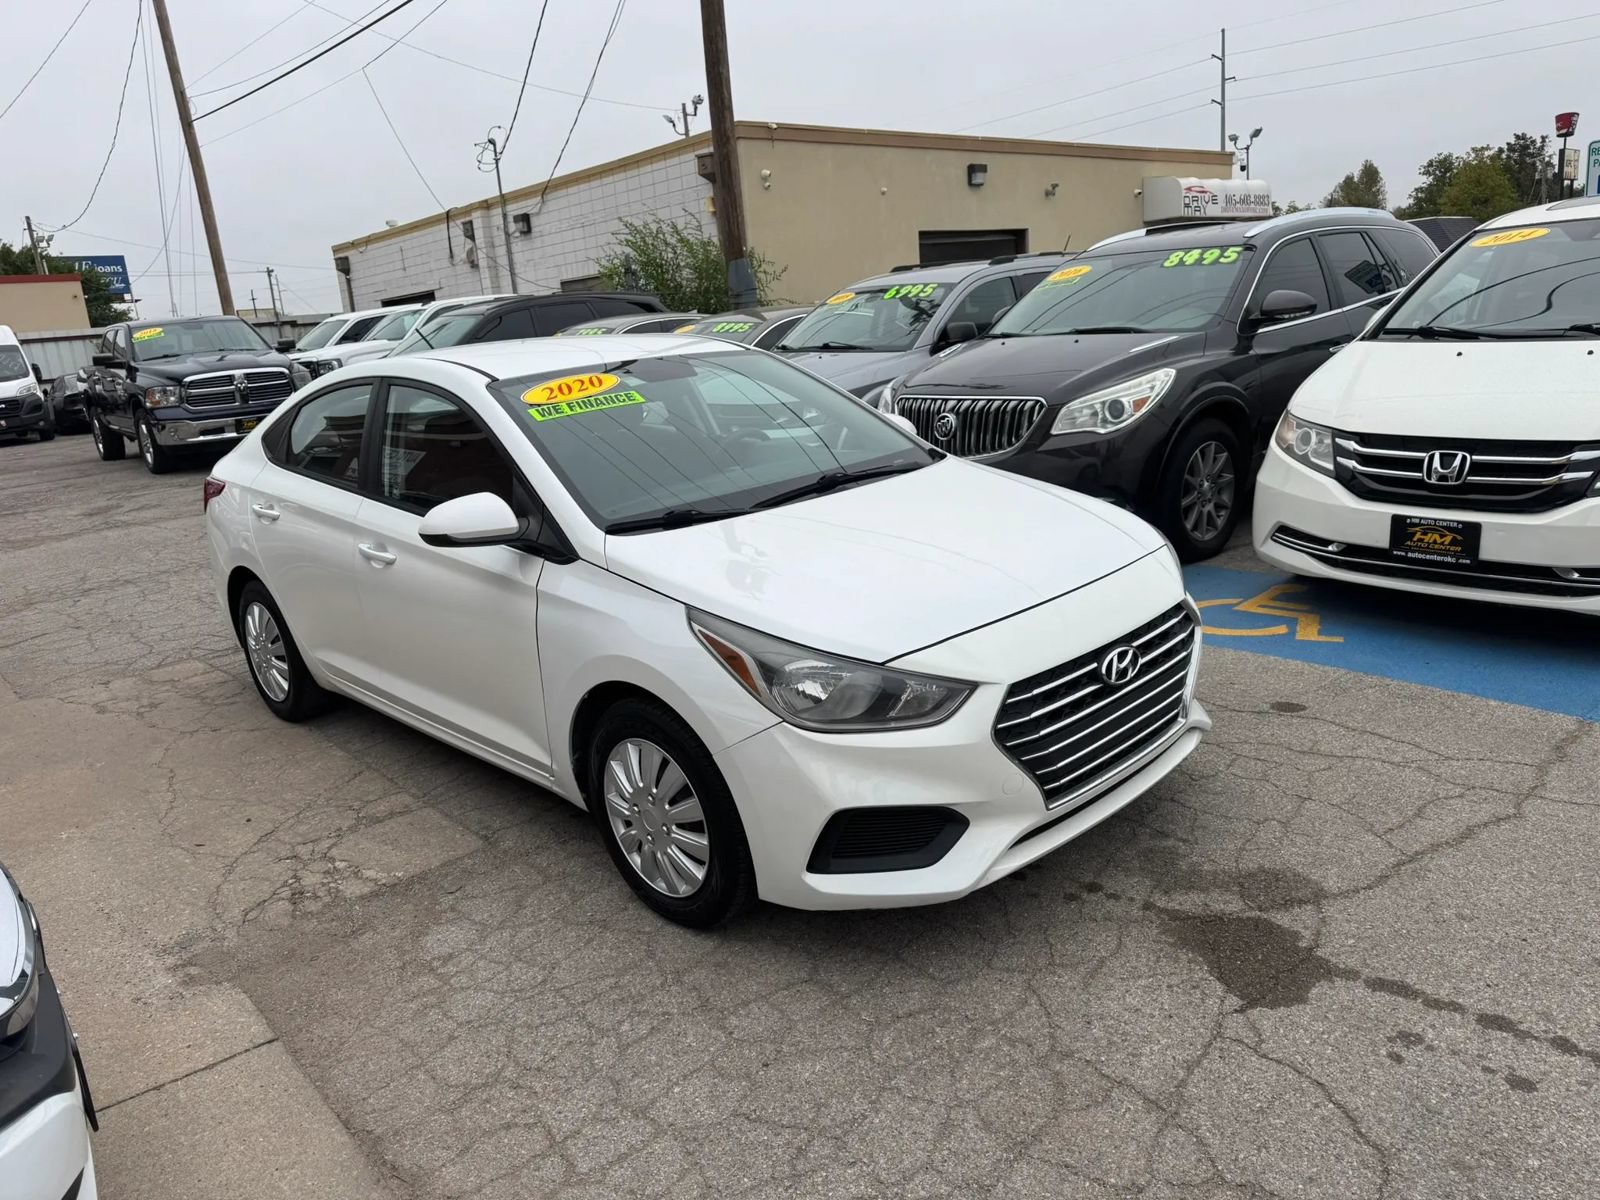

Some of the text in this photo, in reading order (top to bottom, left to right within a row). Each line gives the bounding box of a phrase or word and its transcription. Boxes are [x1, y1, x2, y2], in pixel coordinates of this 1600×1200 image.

[1183, 195, 1218, 206] DRIVE
[1183, 206, 1207, 216] MAX
[1163, 246, 1244, 268] 8495
[883, 283, 938, 300] 6995
[541, 375, 603, 401] 2020
[535, 392, 636, 418] WE FINANCE
[1435, 520, 1458, 528] CENTER
[1412, 532, 1453, 545] HM
[1429, 542, 1462, 552] CENTER
